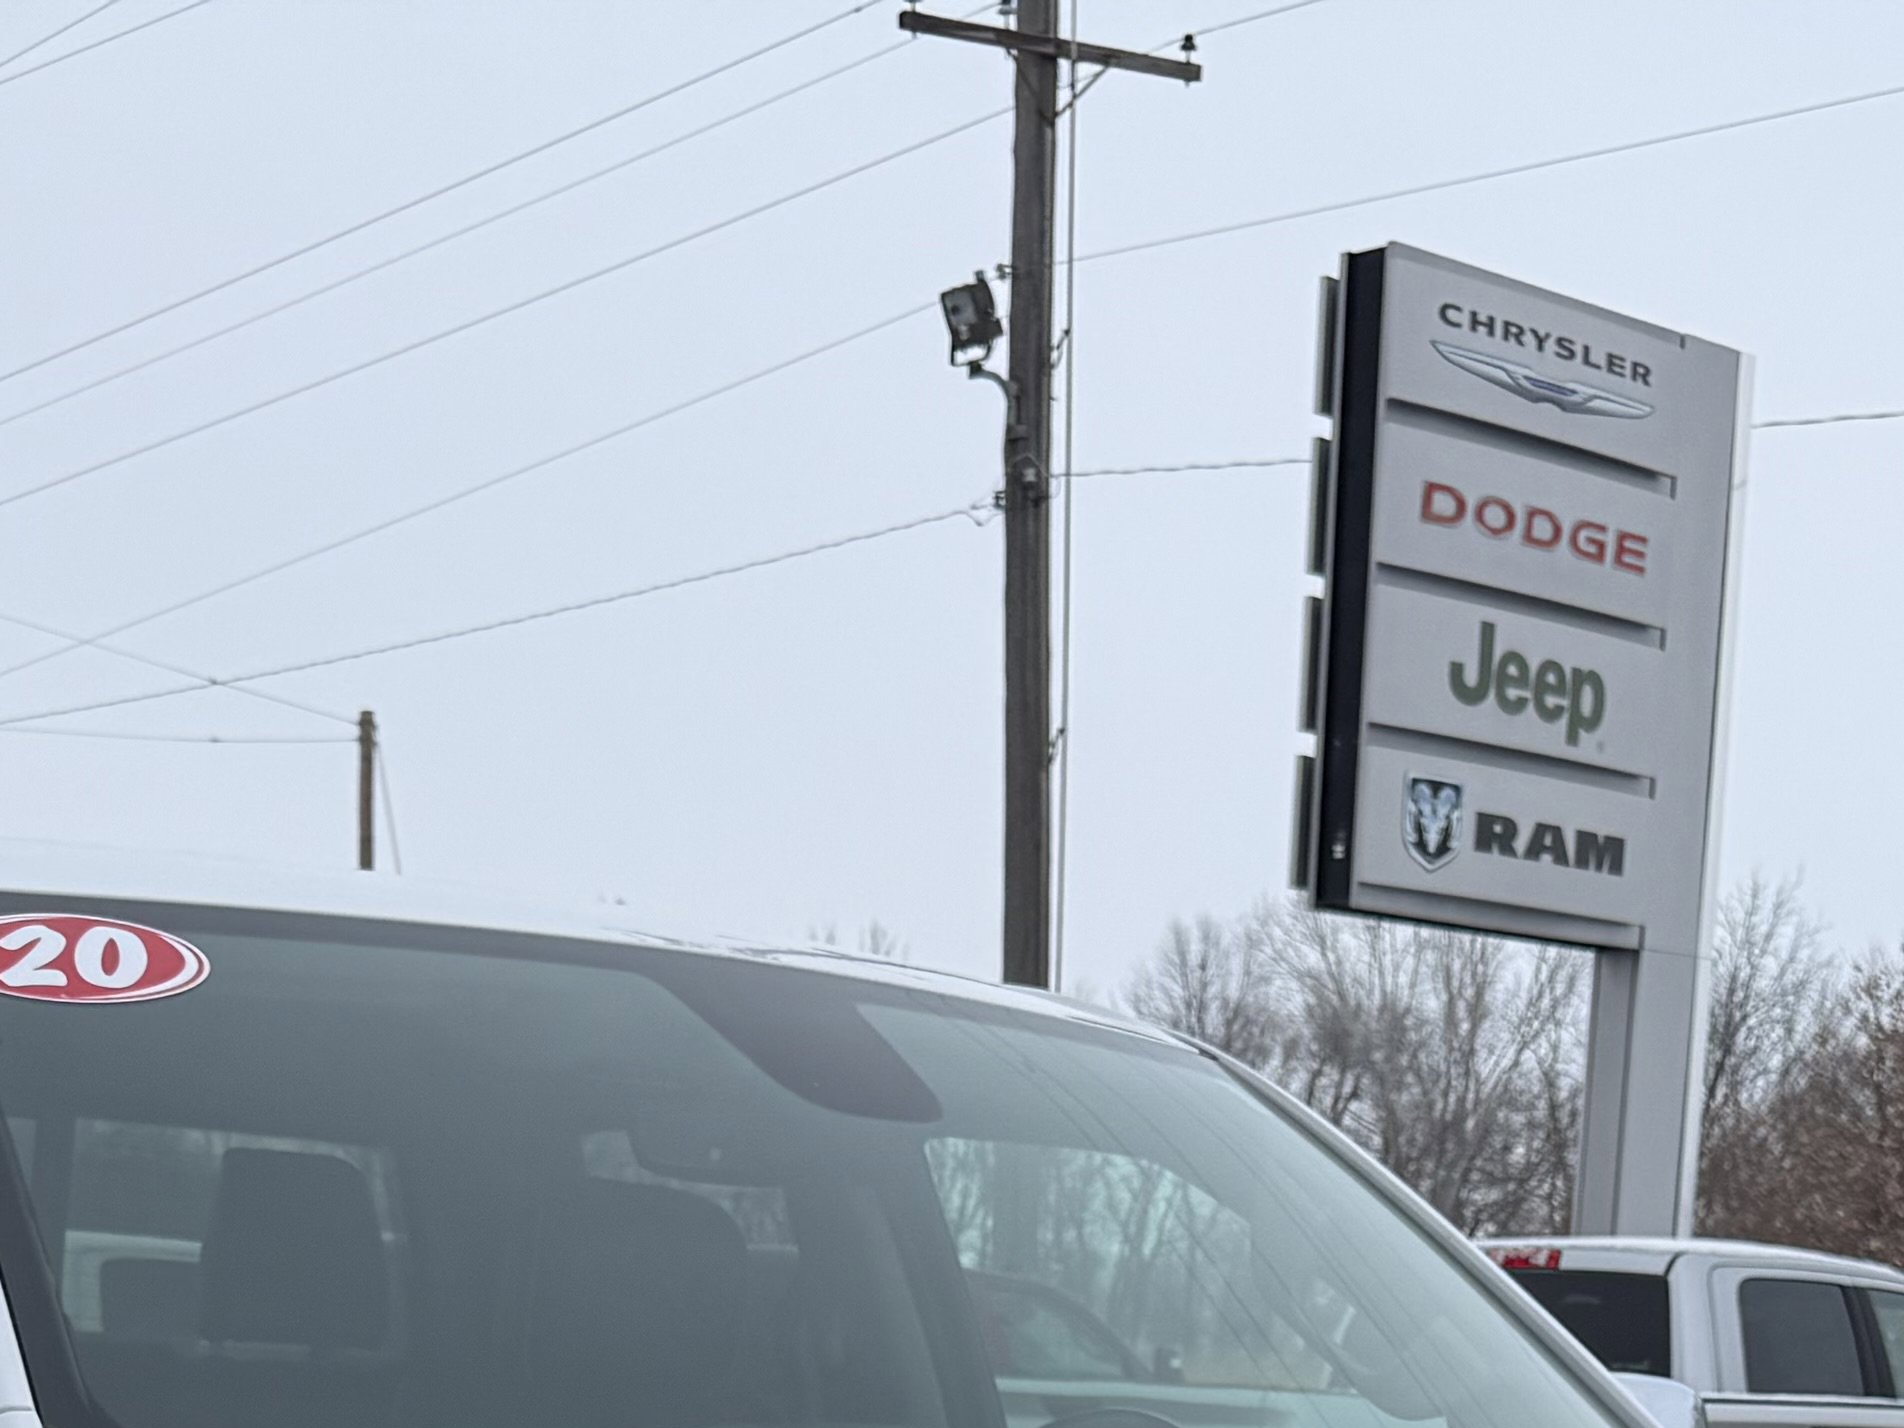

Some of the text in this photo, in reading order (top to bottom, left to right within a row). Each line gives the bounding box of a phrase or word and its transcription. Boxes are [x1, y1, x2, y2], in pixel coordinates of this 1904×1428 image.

[1438, 302, 1654, 388] CHRYSLER
[1421, 480, 1649, 576] DODGE
[1448, 621, 1605, 746] Jeep
[1473, 811, 1626, 876] RAM
